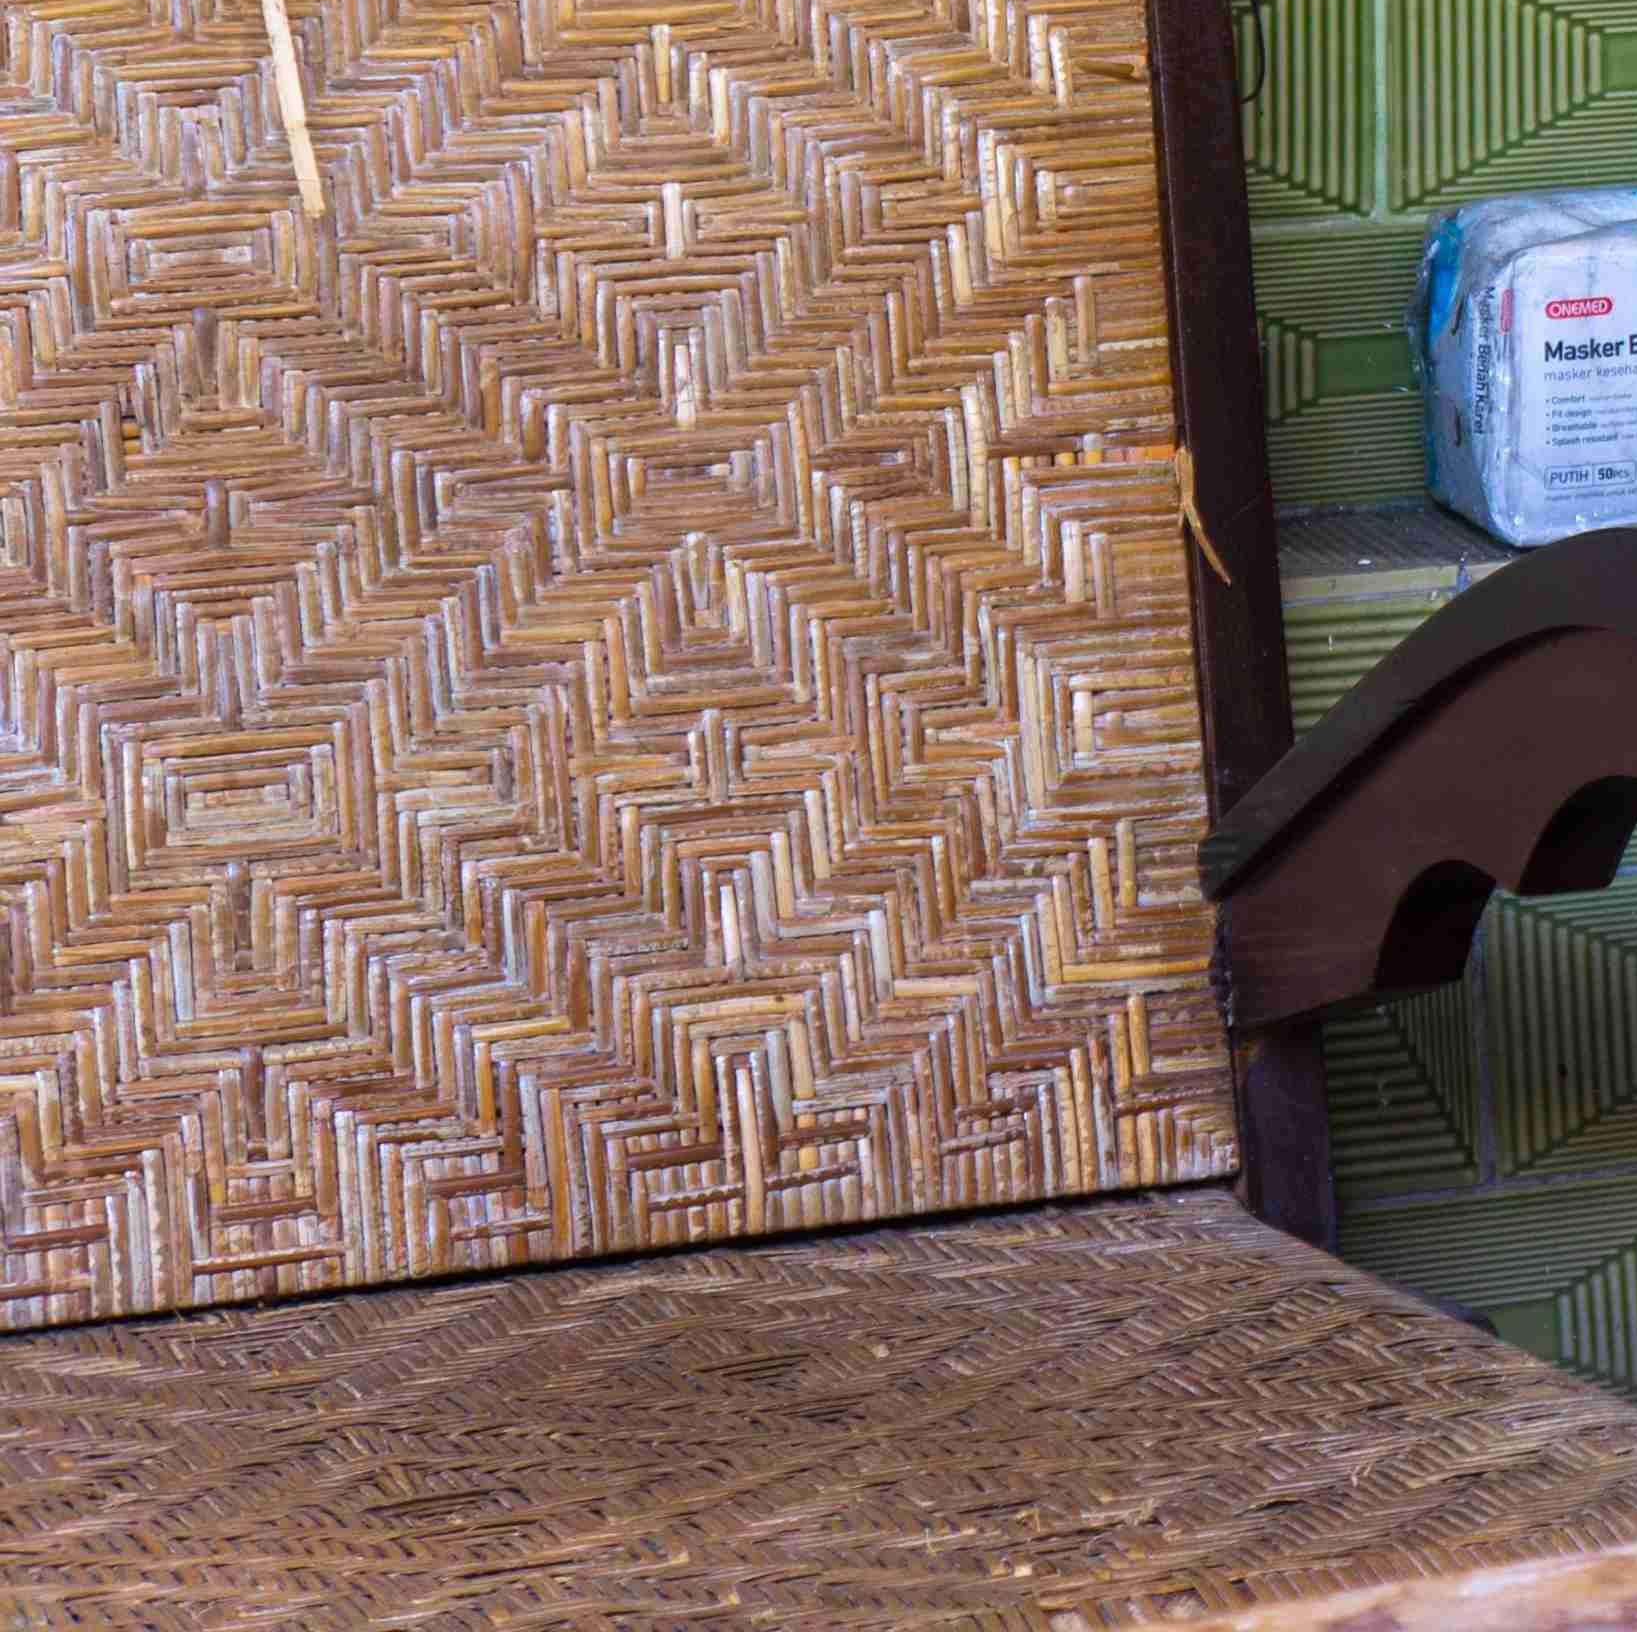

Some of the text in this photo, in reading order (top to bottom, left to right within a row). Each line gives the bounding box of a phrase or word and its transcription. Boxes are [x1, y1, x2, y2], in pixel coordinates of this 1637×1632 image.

[1549, 298, 1609, 318] ONEMED
[1543, 337, 1625, 363] Masker
[1543, 366, 1597, 382] masker
[1551, 394, 1585, 405] Comfort
[1550, 469, 1589, 485] PUTIH
